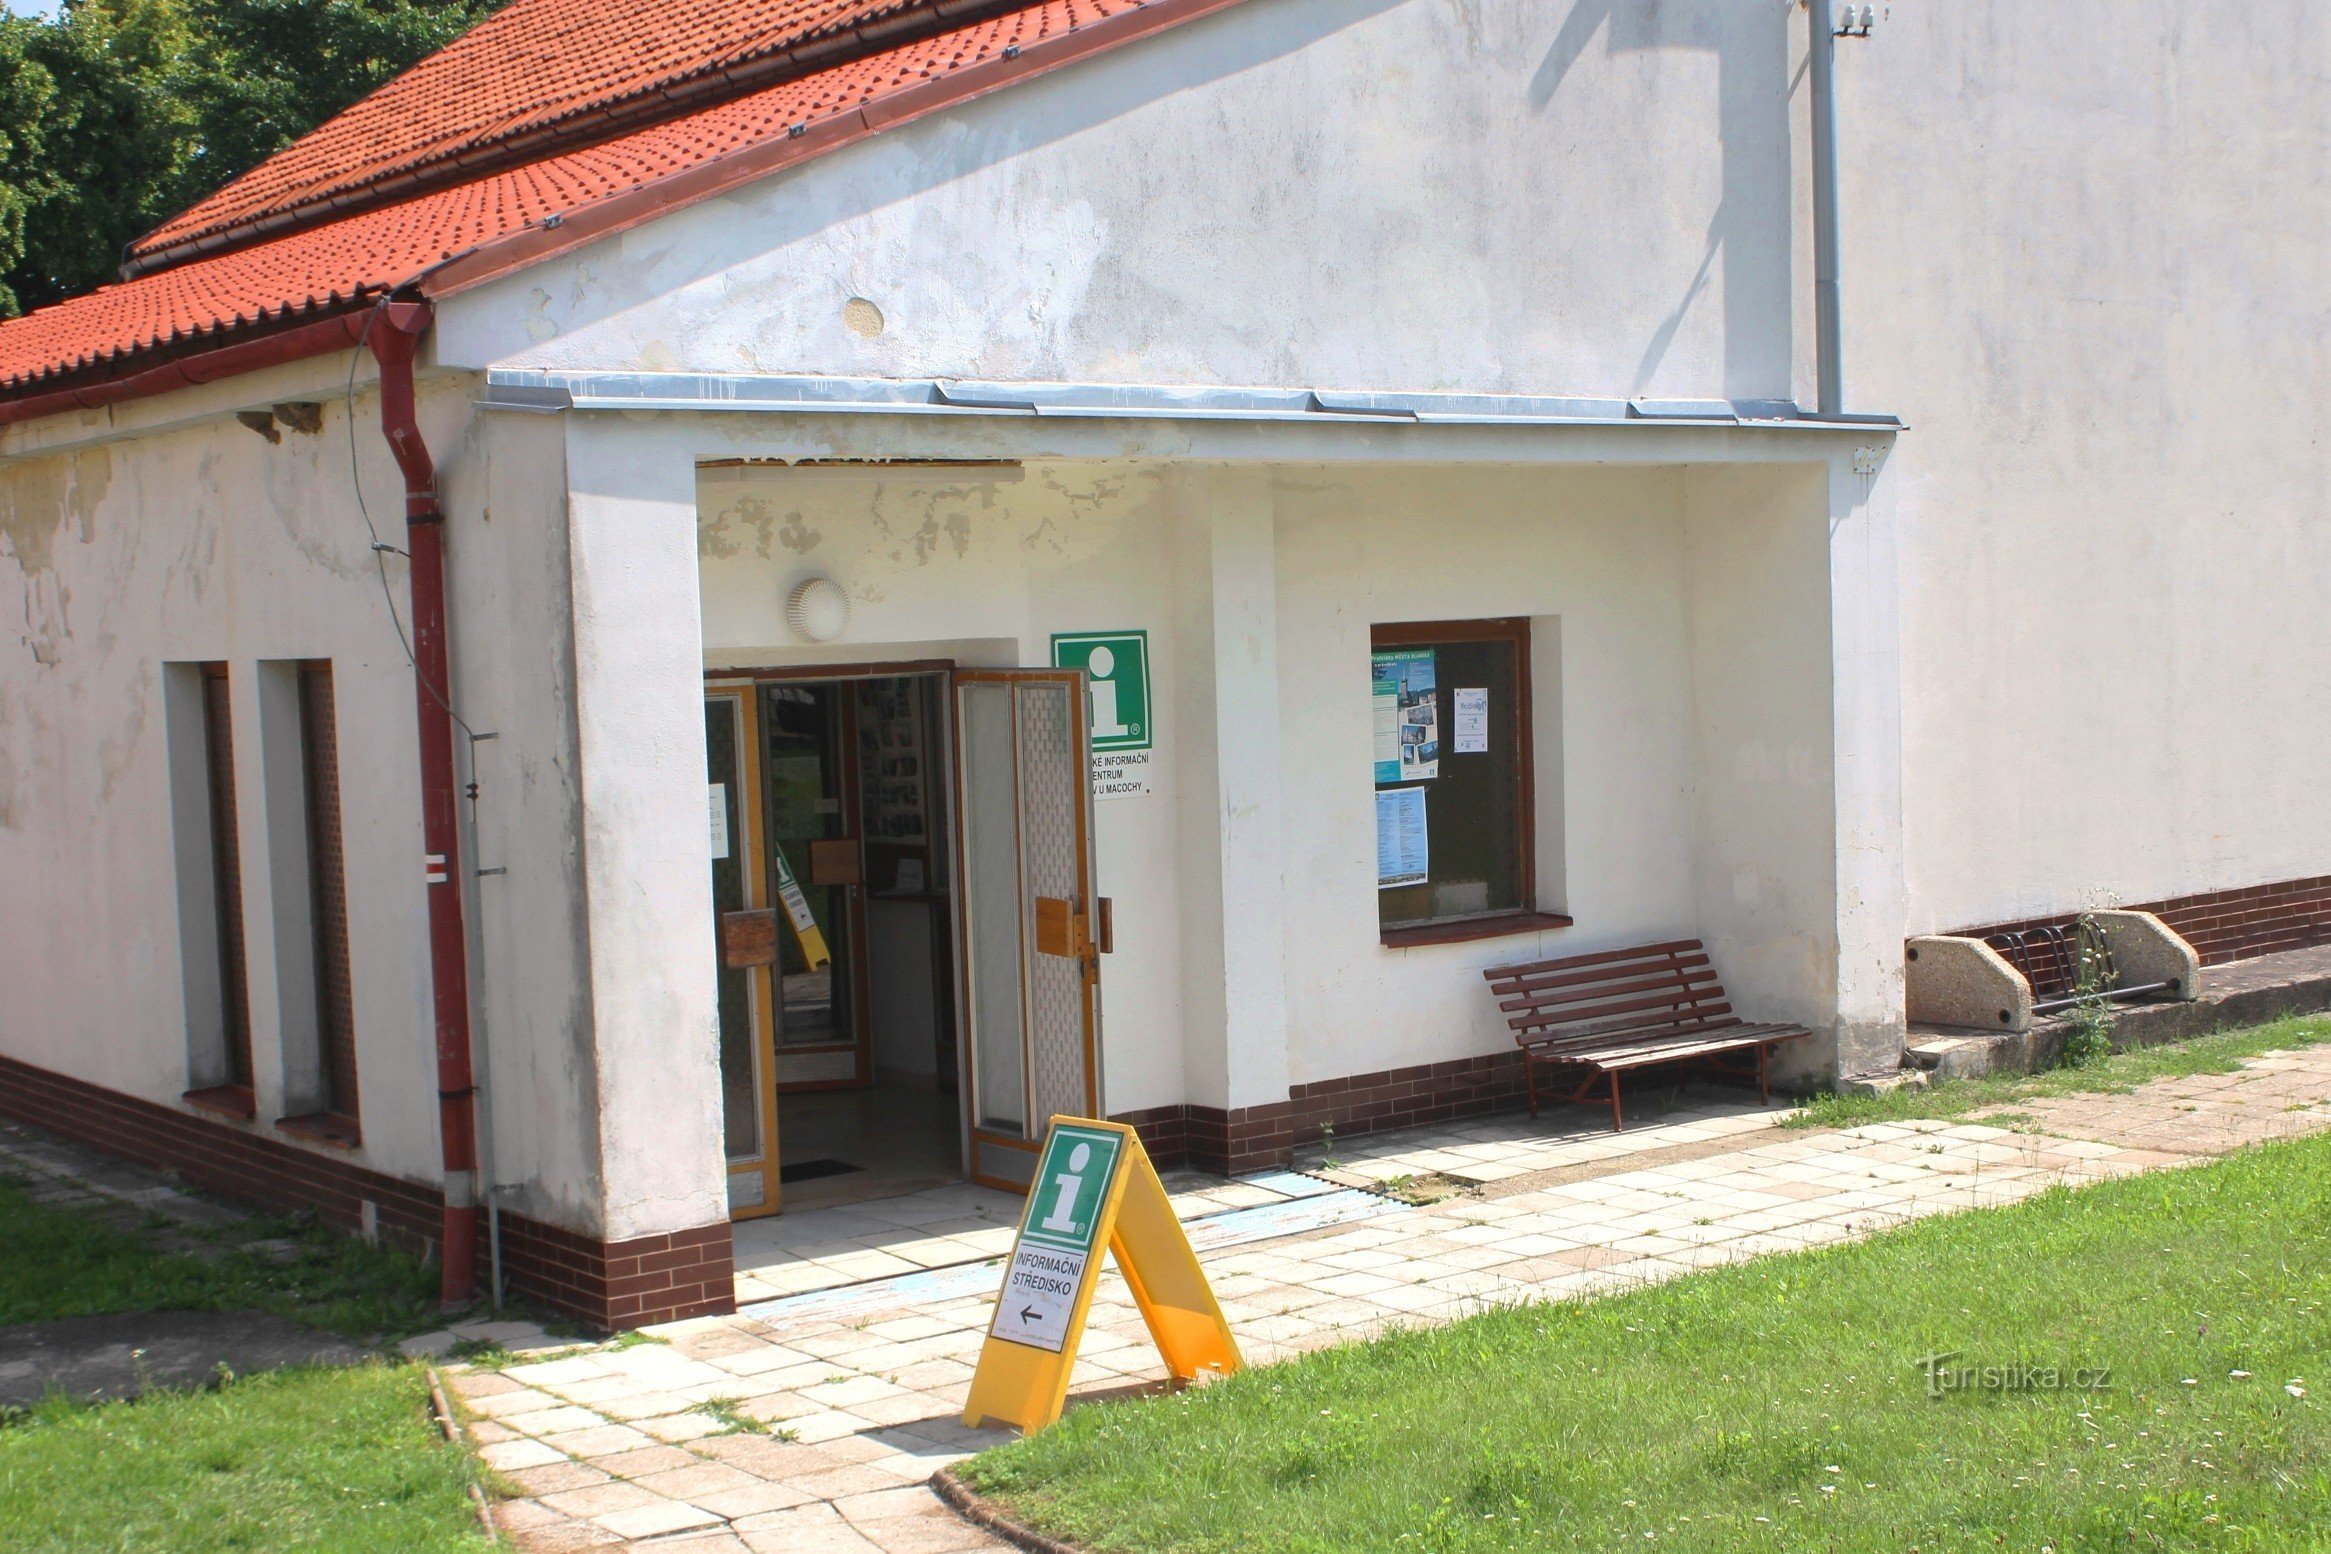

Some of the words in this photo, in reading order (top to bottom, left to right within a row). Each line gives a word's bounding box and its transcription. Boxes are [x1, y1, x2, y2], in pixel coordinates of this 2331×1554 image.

[1092, 755, 1102, 767] KÉ
[1105, 752, 1149, 766] INFORMAČNÍ
[1092, 769, 1123, 780] ENTRUM
[1099, 785, 1104, 794] U
[1106, 782, 1142, 793] MACOCHY
[1015, 1252, 1082, 1277] INFORMAČNÍ
[1012, 1270, 1072, 1296] STŘEDISKO
